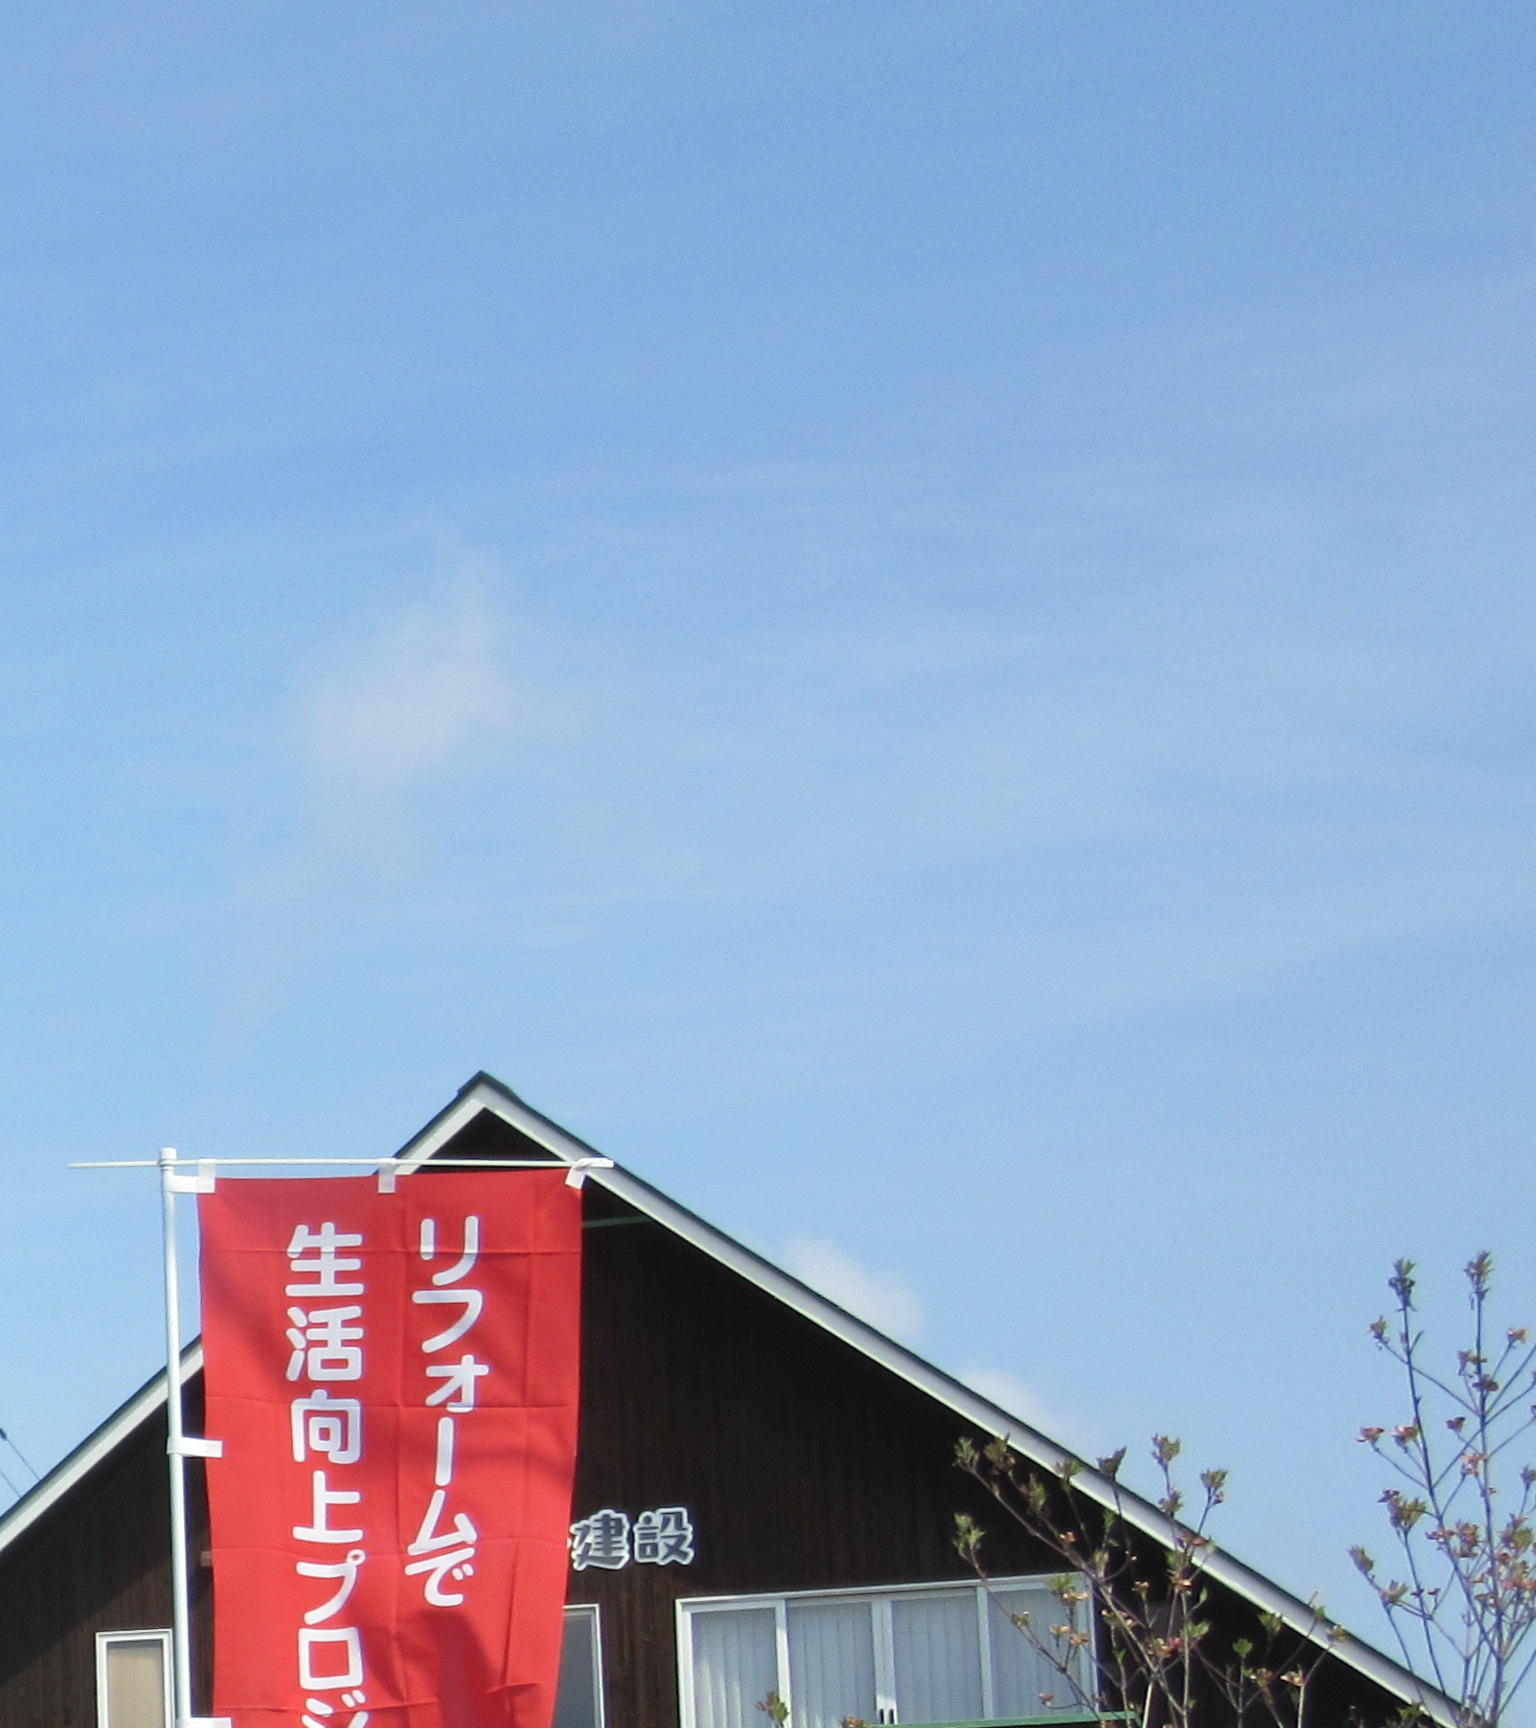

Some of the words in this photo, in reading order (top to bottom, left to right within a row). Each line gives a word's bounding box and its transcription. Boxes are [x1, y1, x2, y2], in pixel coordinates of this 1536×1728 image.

[405, 1214, 489, 1608] リフォームで
[567, 1507, 695, 1571] 建設
